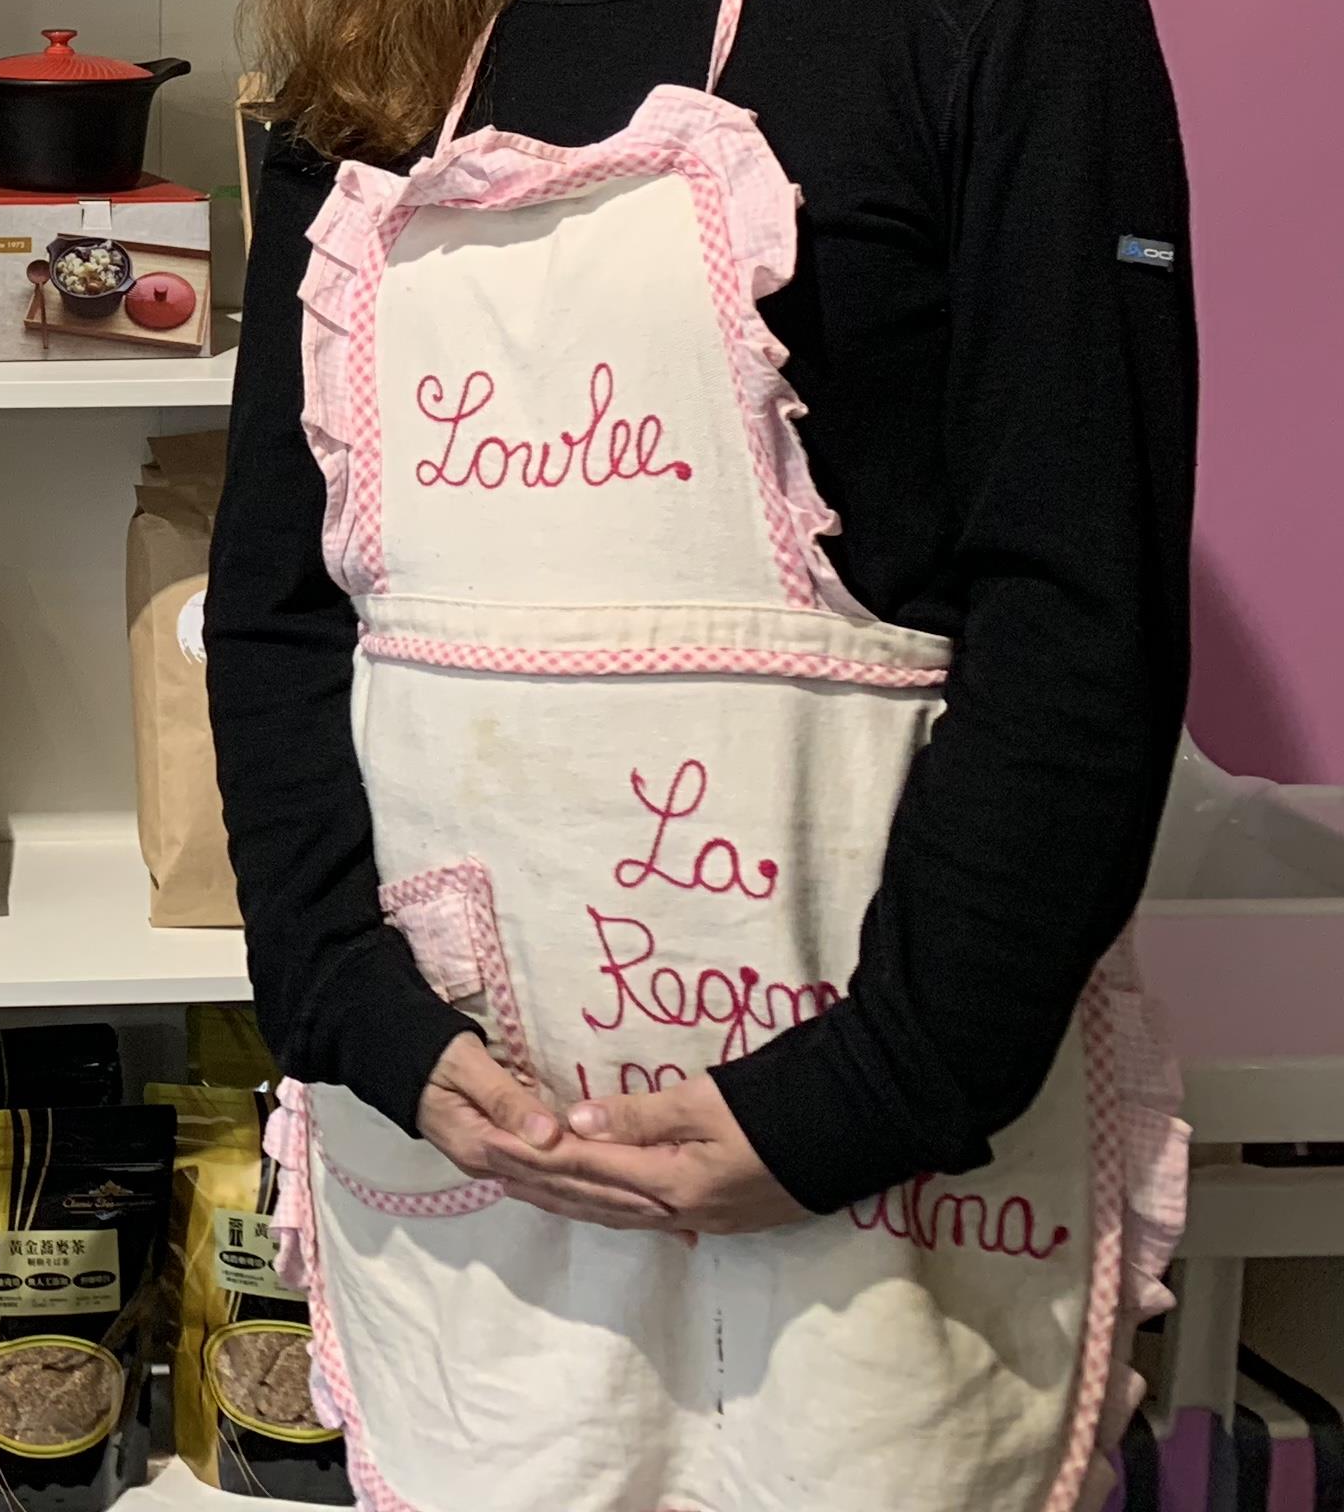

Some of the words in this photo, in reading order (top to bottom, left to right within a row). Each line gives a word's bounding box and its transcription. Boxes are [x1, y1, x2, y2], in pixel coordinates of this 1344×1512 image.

[614, 758, 779, 899] La
[9, 1238, 86, 1256] 黃金蕎麥茶
